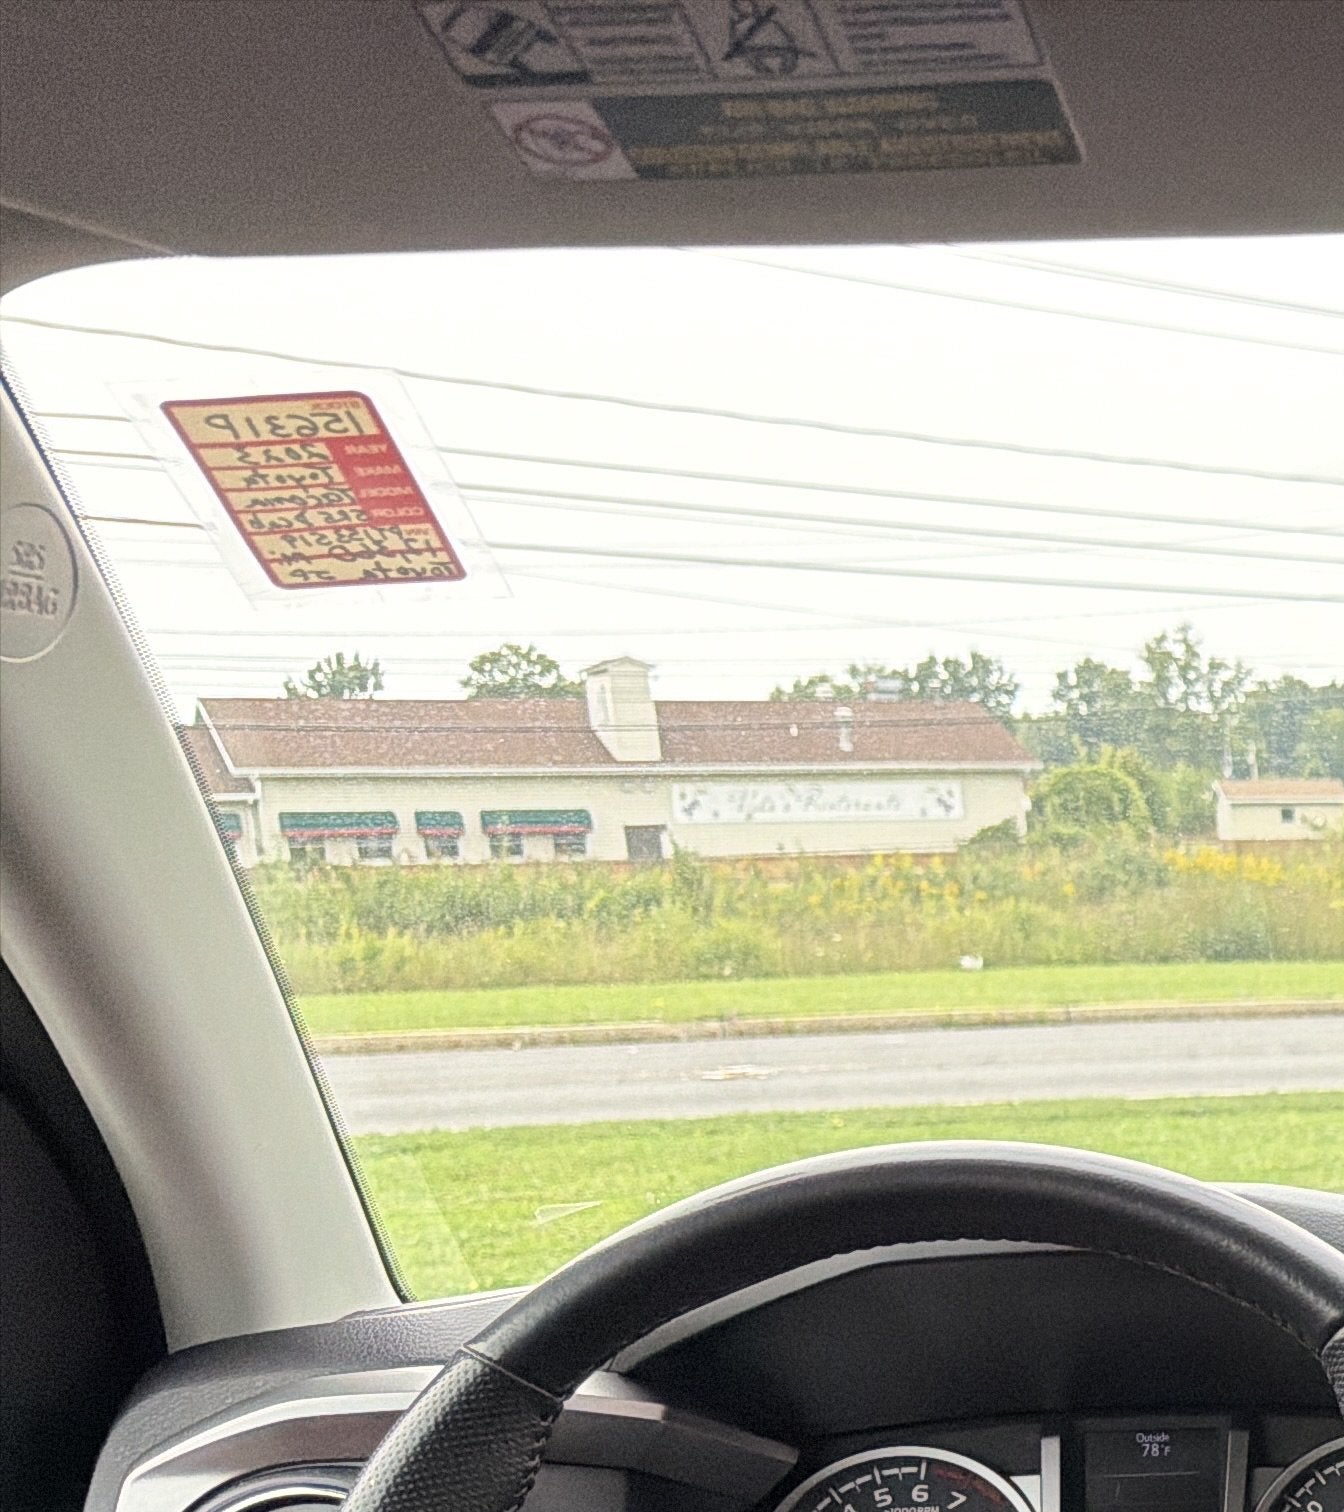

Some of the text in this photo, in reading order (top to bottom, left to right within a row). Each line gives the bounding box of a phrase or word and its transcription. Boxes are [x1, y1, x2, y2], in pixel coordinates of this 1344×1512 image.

[1135, 1432, 1170, 1444] Outside
[873, 1488, 893, 1508] 5
[911, 1484, 929, 1502] 6
[946, 1491, 967, 1510] 7
